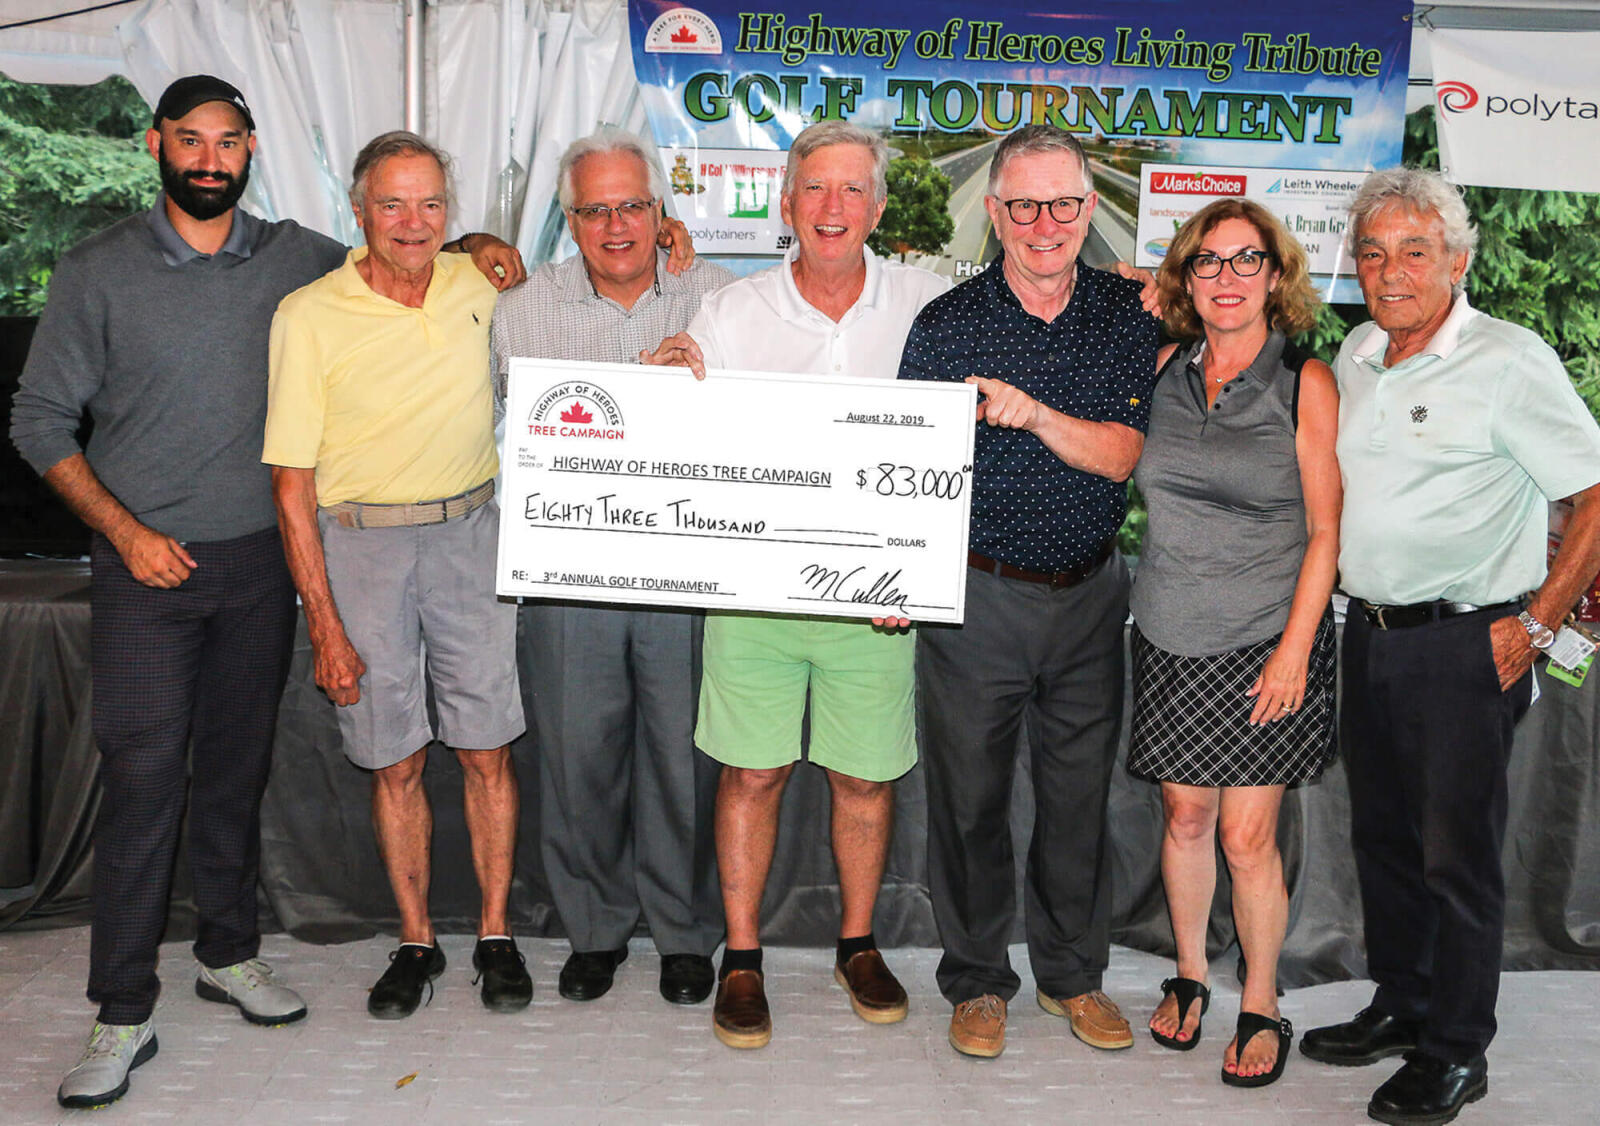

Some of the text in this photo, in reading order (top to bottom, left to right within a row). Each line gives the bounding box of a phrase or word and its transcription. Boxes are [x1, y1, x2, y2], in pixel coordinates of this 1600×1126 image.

[735, 12, 1382, 82] Highway of Heroes Living Tribute
[684, 72, 1353, 144] GOLF TOURNAMENT
[1284, 178, 1312, 189] Leith
[689, 228, 757, 241] polytainers
[1296, 214, 1326, 236] Bryan
[534, 385, 619, 426] HIGHWAY OF HEROES
[847, 412, 924, 425] August 22, 2019
[528, 425, 625, 440] TREE CAMPAIGN
[553, 456, 832, 484] HIGHWAY OF HEROES TREE CAMPAIGN
[524, 492, 767, 535] EIGHTY THREE THOUSAND
[887, 537, 926, 548] DOLLARS
[511, 570, 720, 593] RE: 3rd ANNUAL GOLF TOURNAMENT
